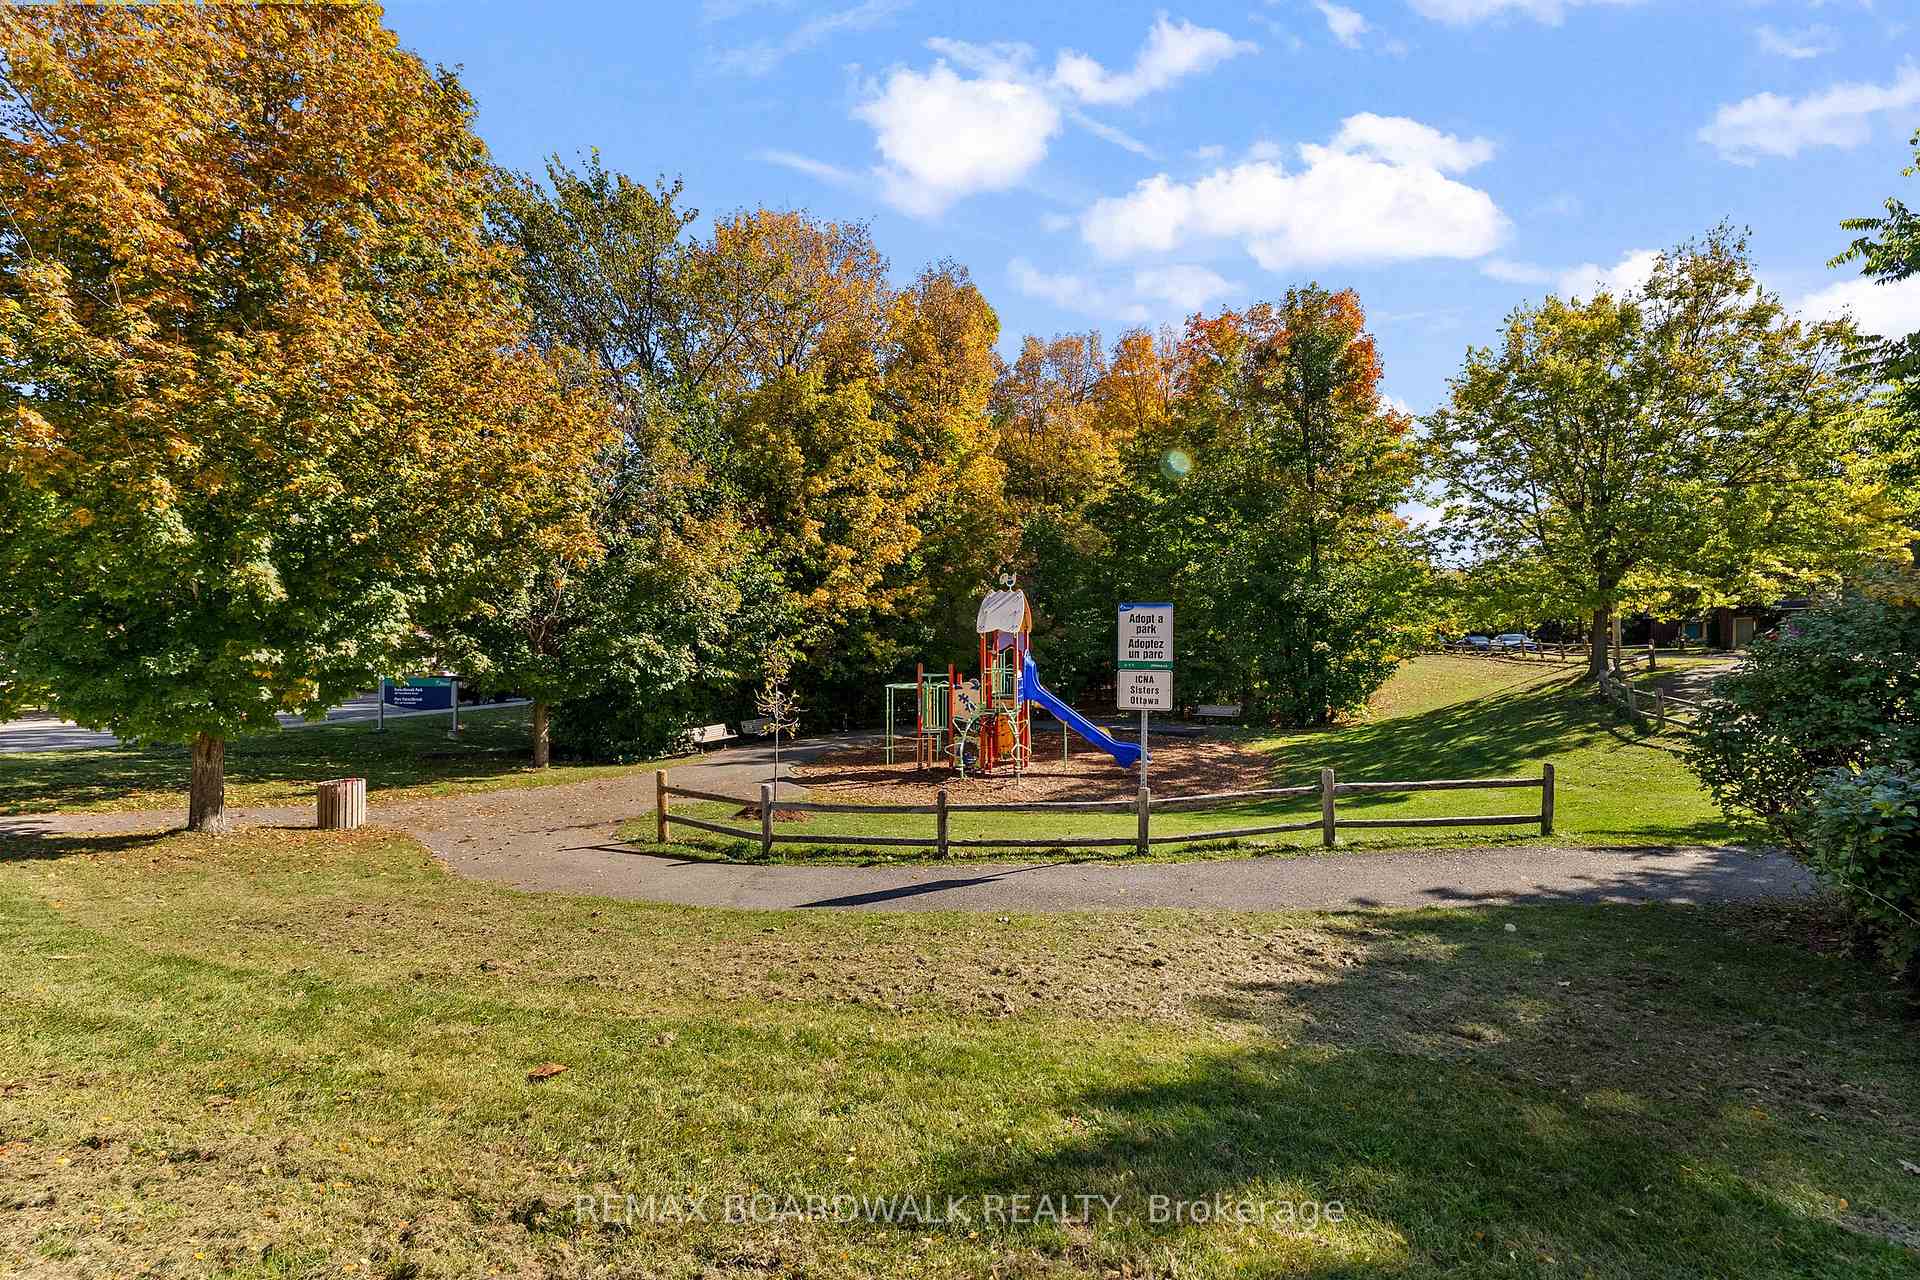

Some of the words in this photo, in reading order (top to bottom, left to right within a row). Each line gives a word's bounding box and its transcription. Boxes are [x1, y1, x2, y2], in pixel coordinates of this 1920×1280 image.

[1129, 613, 1155, 625] Adopt
[1158, 615, 1164, 624] a
[1136, 624, 1157, 635] park
[1128, 638, 1164, 649] Adoptez
[1128, 650, 1140, 659] un
[1143, 650, 1164, 660] parc
[1135, 675, 1154, 684] ICNA
[1130, 685, 1160, 695] Sisters
[1130, 696, 1159, 705] Ottawa
